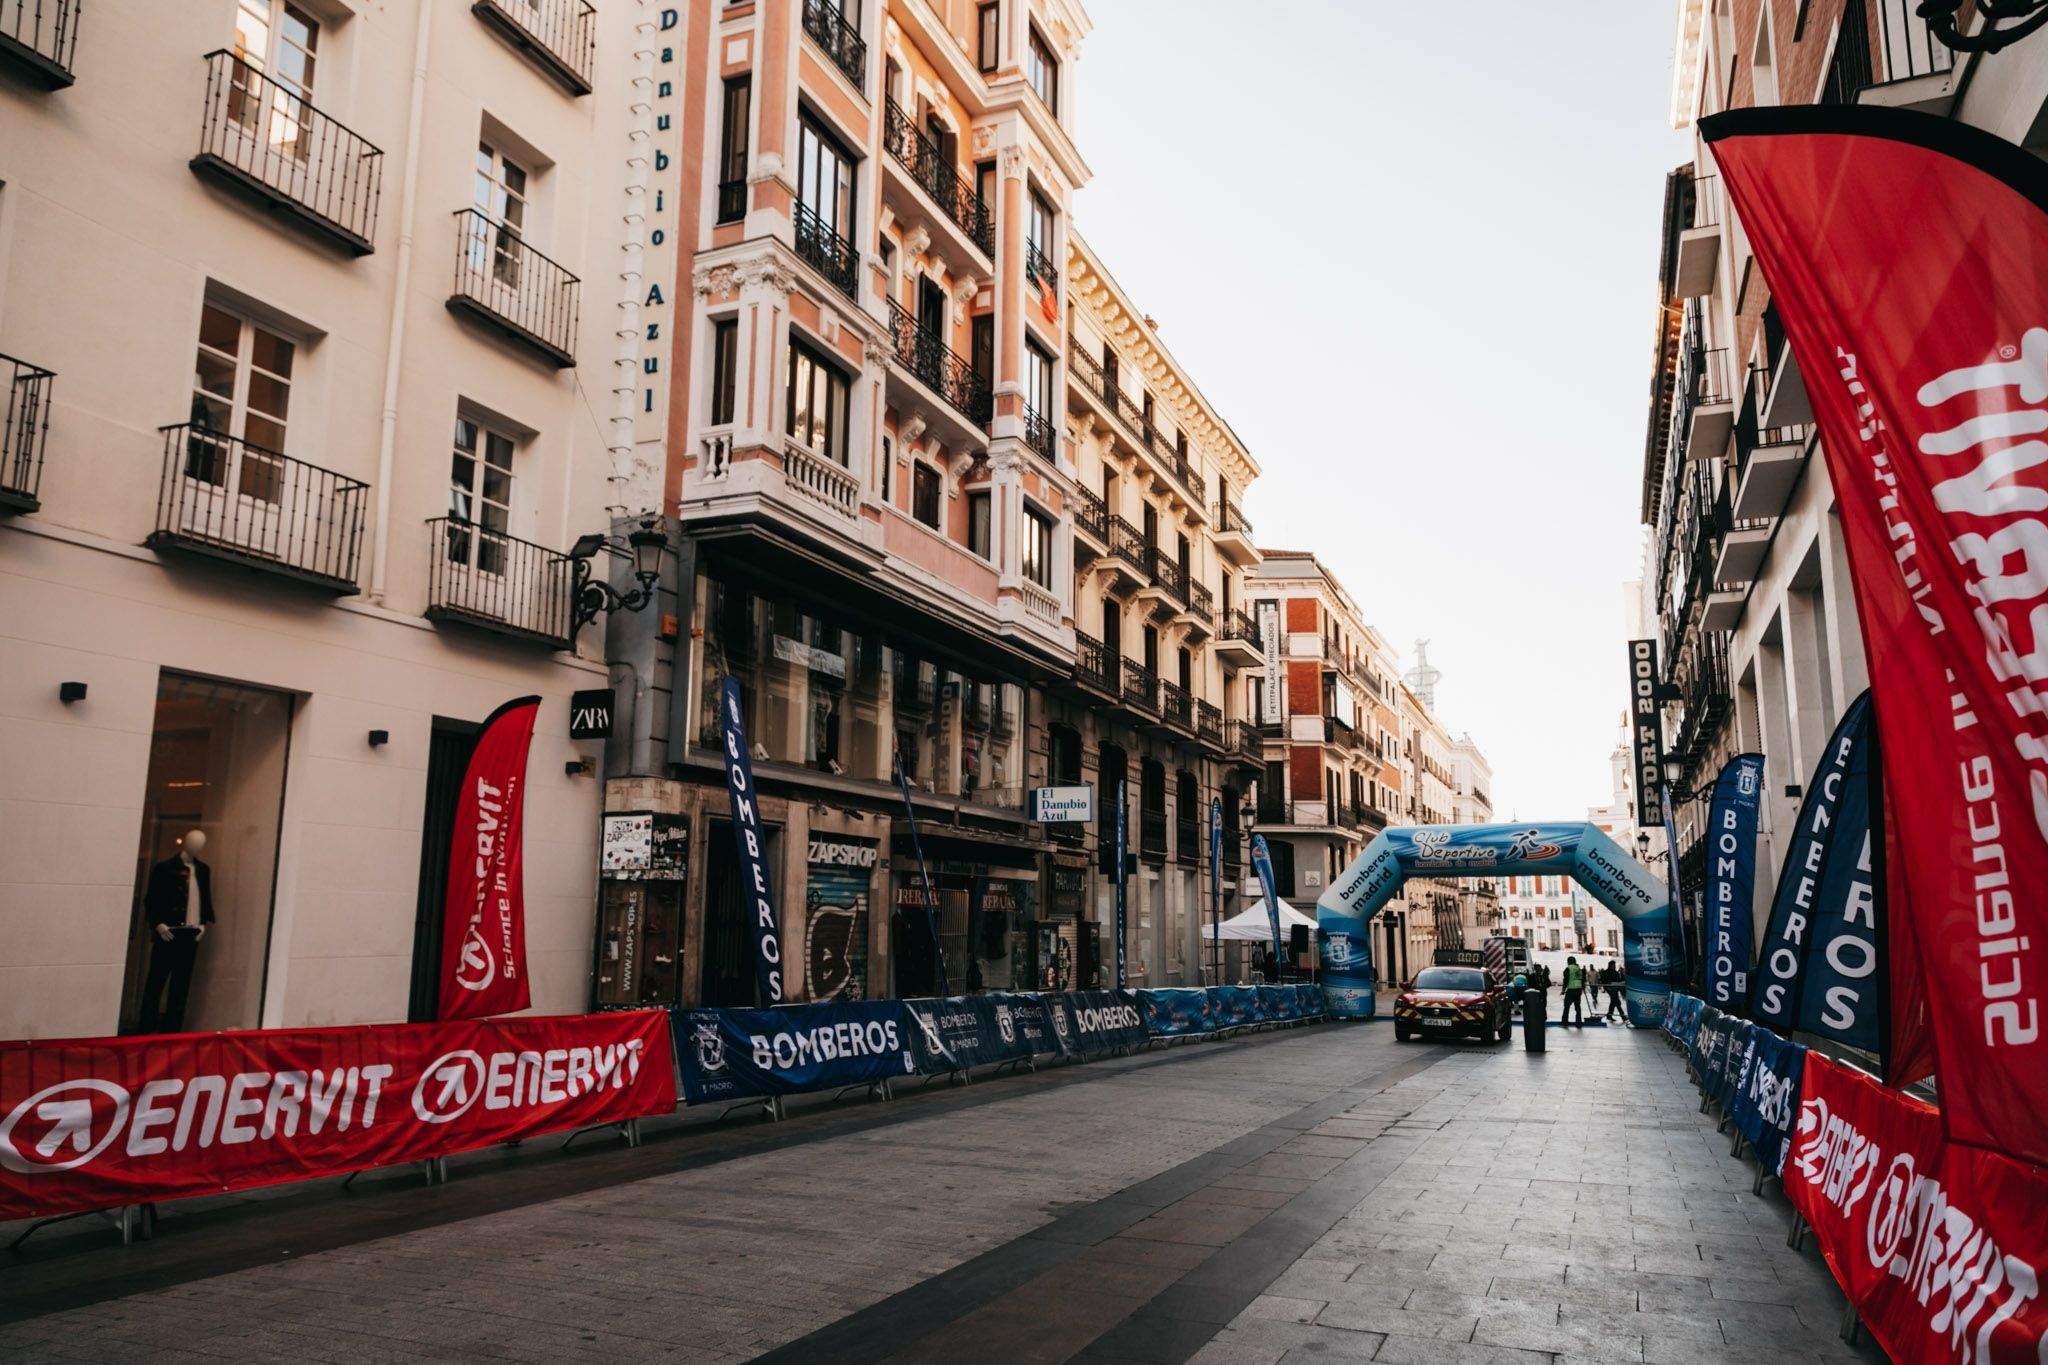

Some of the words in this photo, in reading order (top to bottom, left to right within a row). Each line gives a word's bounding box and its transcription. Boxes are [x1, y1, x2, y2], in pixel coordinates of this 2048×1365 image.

[651, 8, 678, 247] Danubio
[644, 284, 664, 412] Azul
[1267, 622, 1275, 663] PRECIADOS
[1635, 642, 1654, 714] 2000
[572, 707, 610, 730] ZARA
[1042, 789, 1053, 799] El
[1640, 725, 1661, 824] SPORT
[1042, 799, 1087, 810] Danubio
[1042, 810, 1067, 820] Azul
[807, 842, 877, 867] ZAPSHOP
[1414, 832, 1449, 844] Club
[1421, 843, 1496, 861] Deportivo
[494, 871, 508, 892] in
[727, 730, 782, 1001] BOMBEROS
[1340, 850, 1390, 900] bomberos
[1578, 862, 1632, 906] madrid
[1588, 848, 1652, 904] bomberos
[1352, 867, 1393, 912] madrid
[1715, 809, 1737, 1002] BOMBEROS
[497, 897, 517, 979] Science
[940, 1012, 977, 1029] BOMBEROS
[1076, 1006, 1142, 1034] BOMBEROS
[750, 1019, 900, 1071] BOMBEROS
[485, 1039, 644, 1111] ENERVIT
[127, 1064, 395, 1157] ENERVIT
